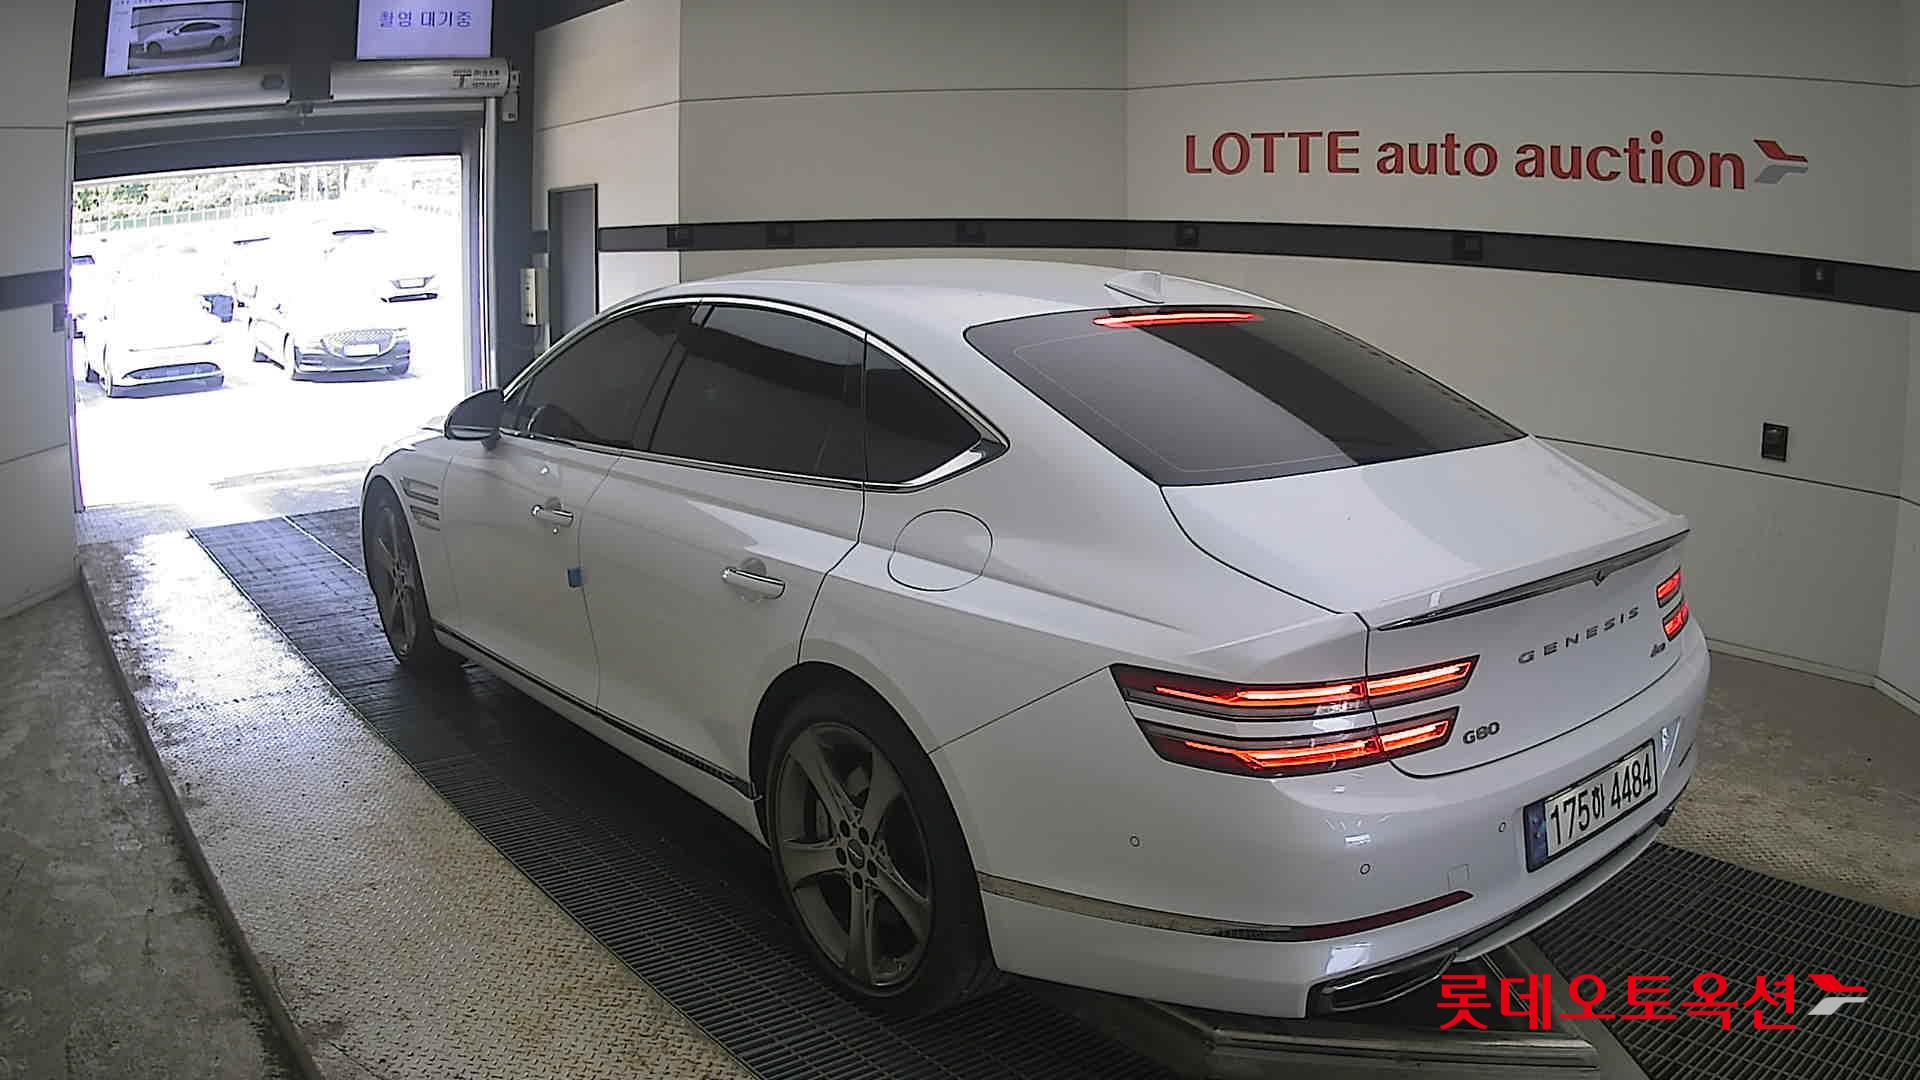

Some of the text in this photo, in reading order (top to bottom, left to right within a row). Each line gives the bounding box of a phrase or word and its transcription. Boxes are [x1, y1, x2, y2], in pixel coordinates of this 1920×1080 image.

[420, 10, 472, 28] 대기중
[1186, 130, 1745, 190] LOTTE auto auction
[1518, 606, 1640, 664] GENESIS
[1463, 721, 1501, 745] G80
[1611, 753, 1652, 809] 4484
